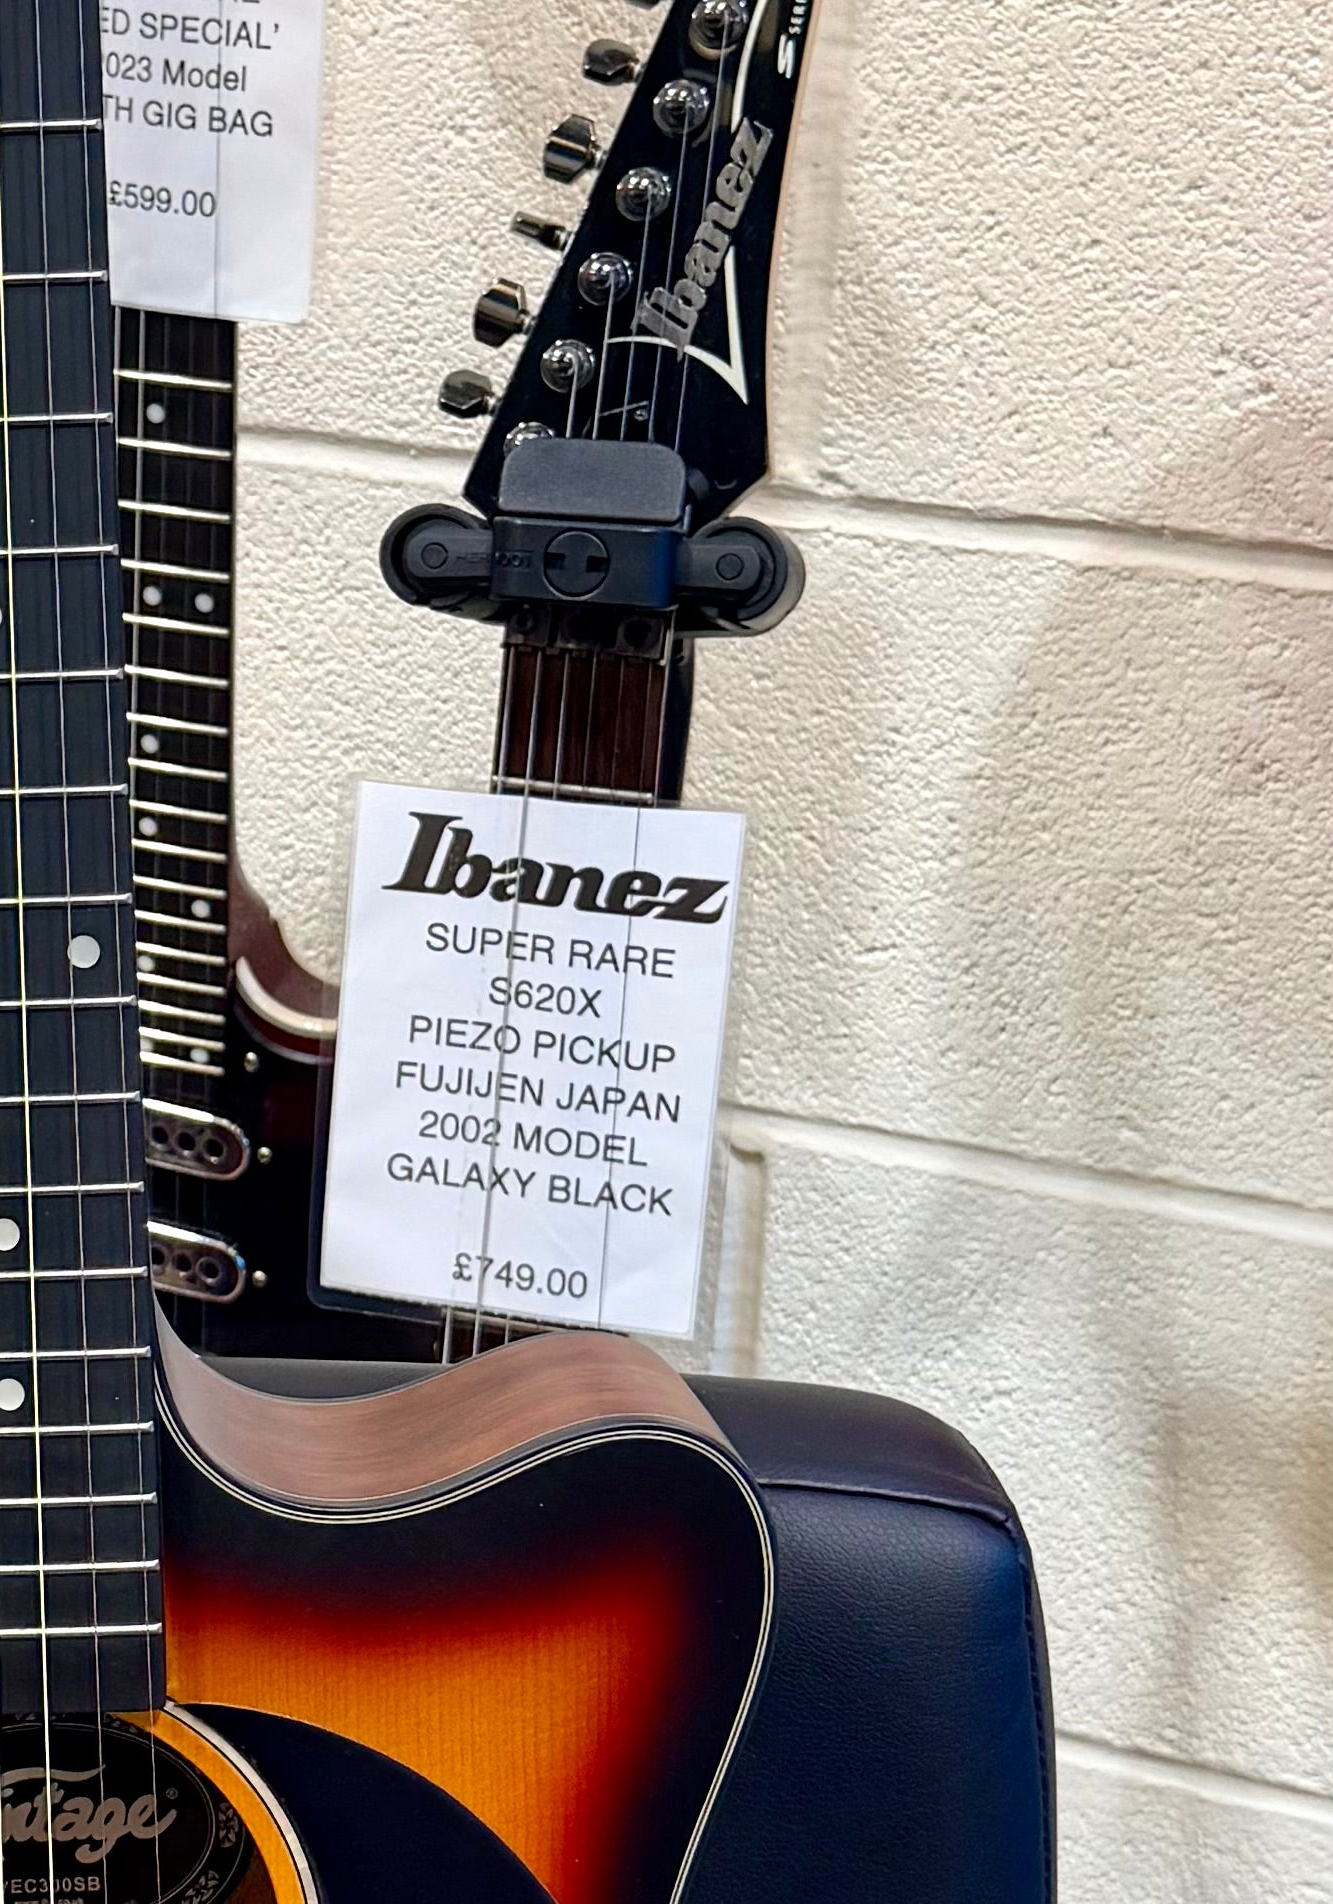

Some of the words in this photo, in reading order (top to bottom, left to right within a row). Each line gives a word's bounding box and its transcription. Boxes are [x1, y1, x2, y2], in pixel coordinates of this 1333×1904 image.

[141, 11, 279, 50] SPECIAL'
[99, 51, 152, 83] 023
[163, 58, 247, 91] Model
[142, 99, 196, 130] GIG
[208, 106, 273, 137] BAG
[108, 179, 216, 217] £599.00
[631, 117, 774, 361] Ibanez
[381, 811, 729, 924] Ibanez
[425, 922, 555, 965] SUPER
[567, 939, 676, 979] RARE
[488, 977, 602, 1018] S620X
[409, 1015, 521, 1055] PIEZO
[533, 1032, 677, 1074] PICKUP
[396, 1061, 545, 1106] FUJIJEN
[555, 1082, 680, 1123] JAPAN
[418, 1110, 501, 1147] 2002
[513, 1122, 648, 1166] MODEL
[387, 1152, 537, 1197] GALAXY
[547, 1174, 673, 1216] BLACK
[452, 1251, 588, 1298] £749.00
